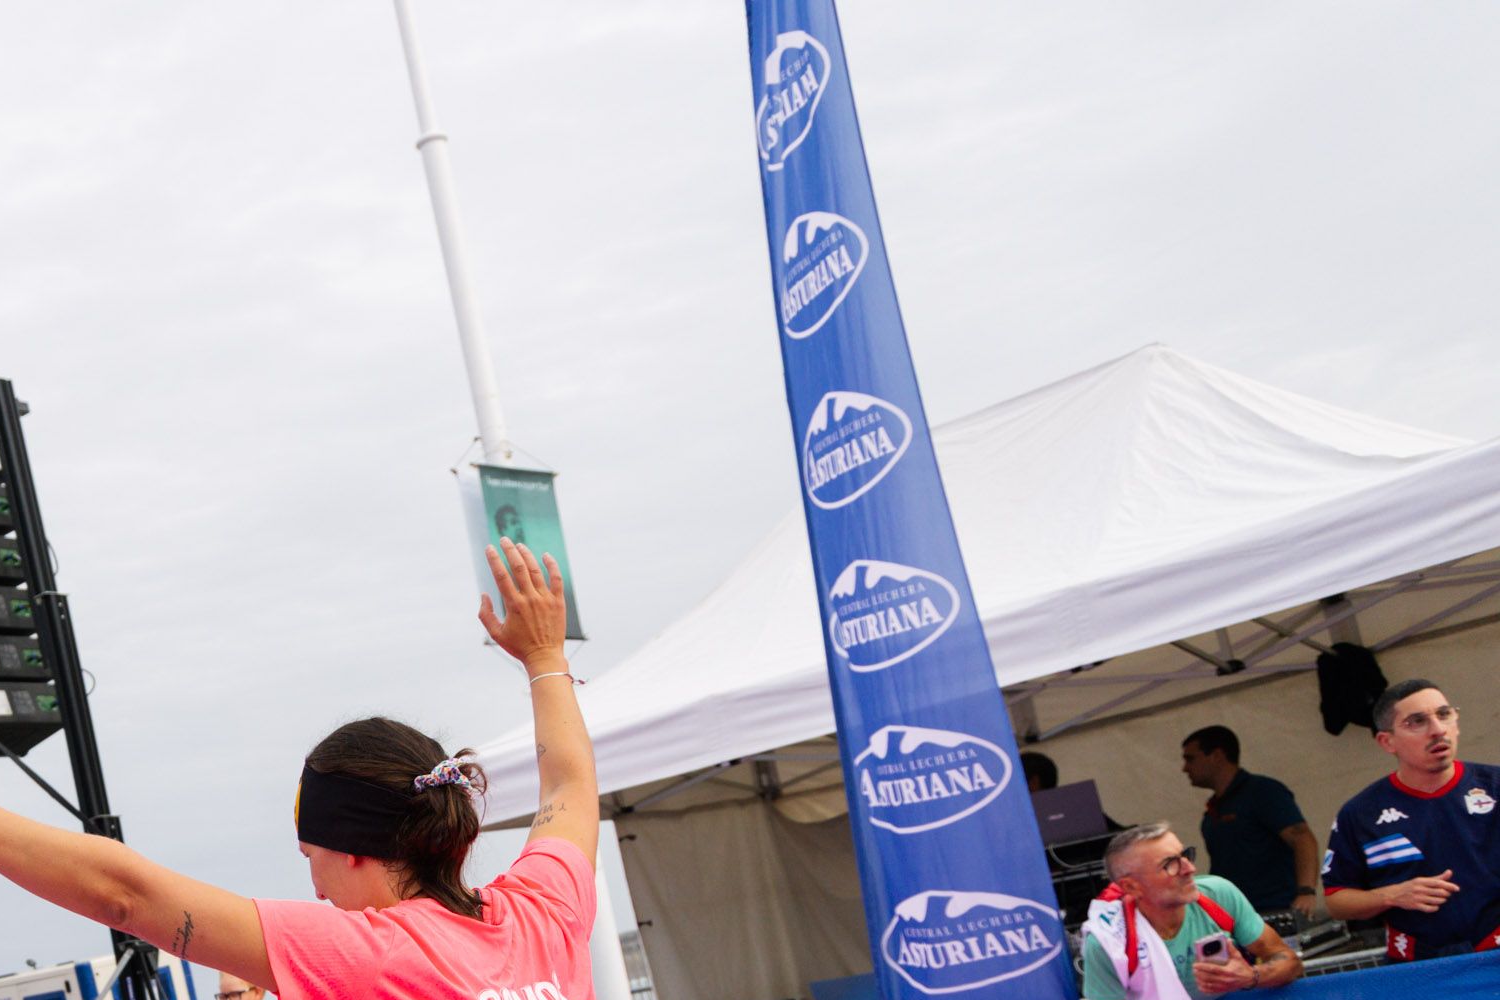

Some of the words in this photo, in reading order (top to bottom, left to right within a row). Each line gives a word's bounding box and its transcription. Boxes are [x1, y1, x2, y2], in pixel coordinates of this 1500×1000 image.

[808, 425, 897, 493] ASTURIANA
[871, 582, 927, 609] LECHERA
[841, 596, 945, 649] STURIANA
[909, 748, 978, 770] LECHERA
[956, 910, 1035, 932] LECHERA
[898, 923, 1054, 970] ASTURIANA
